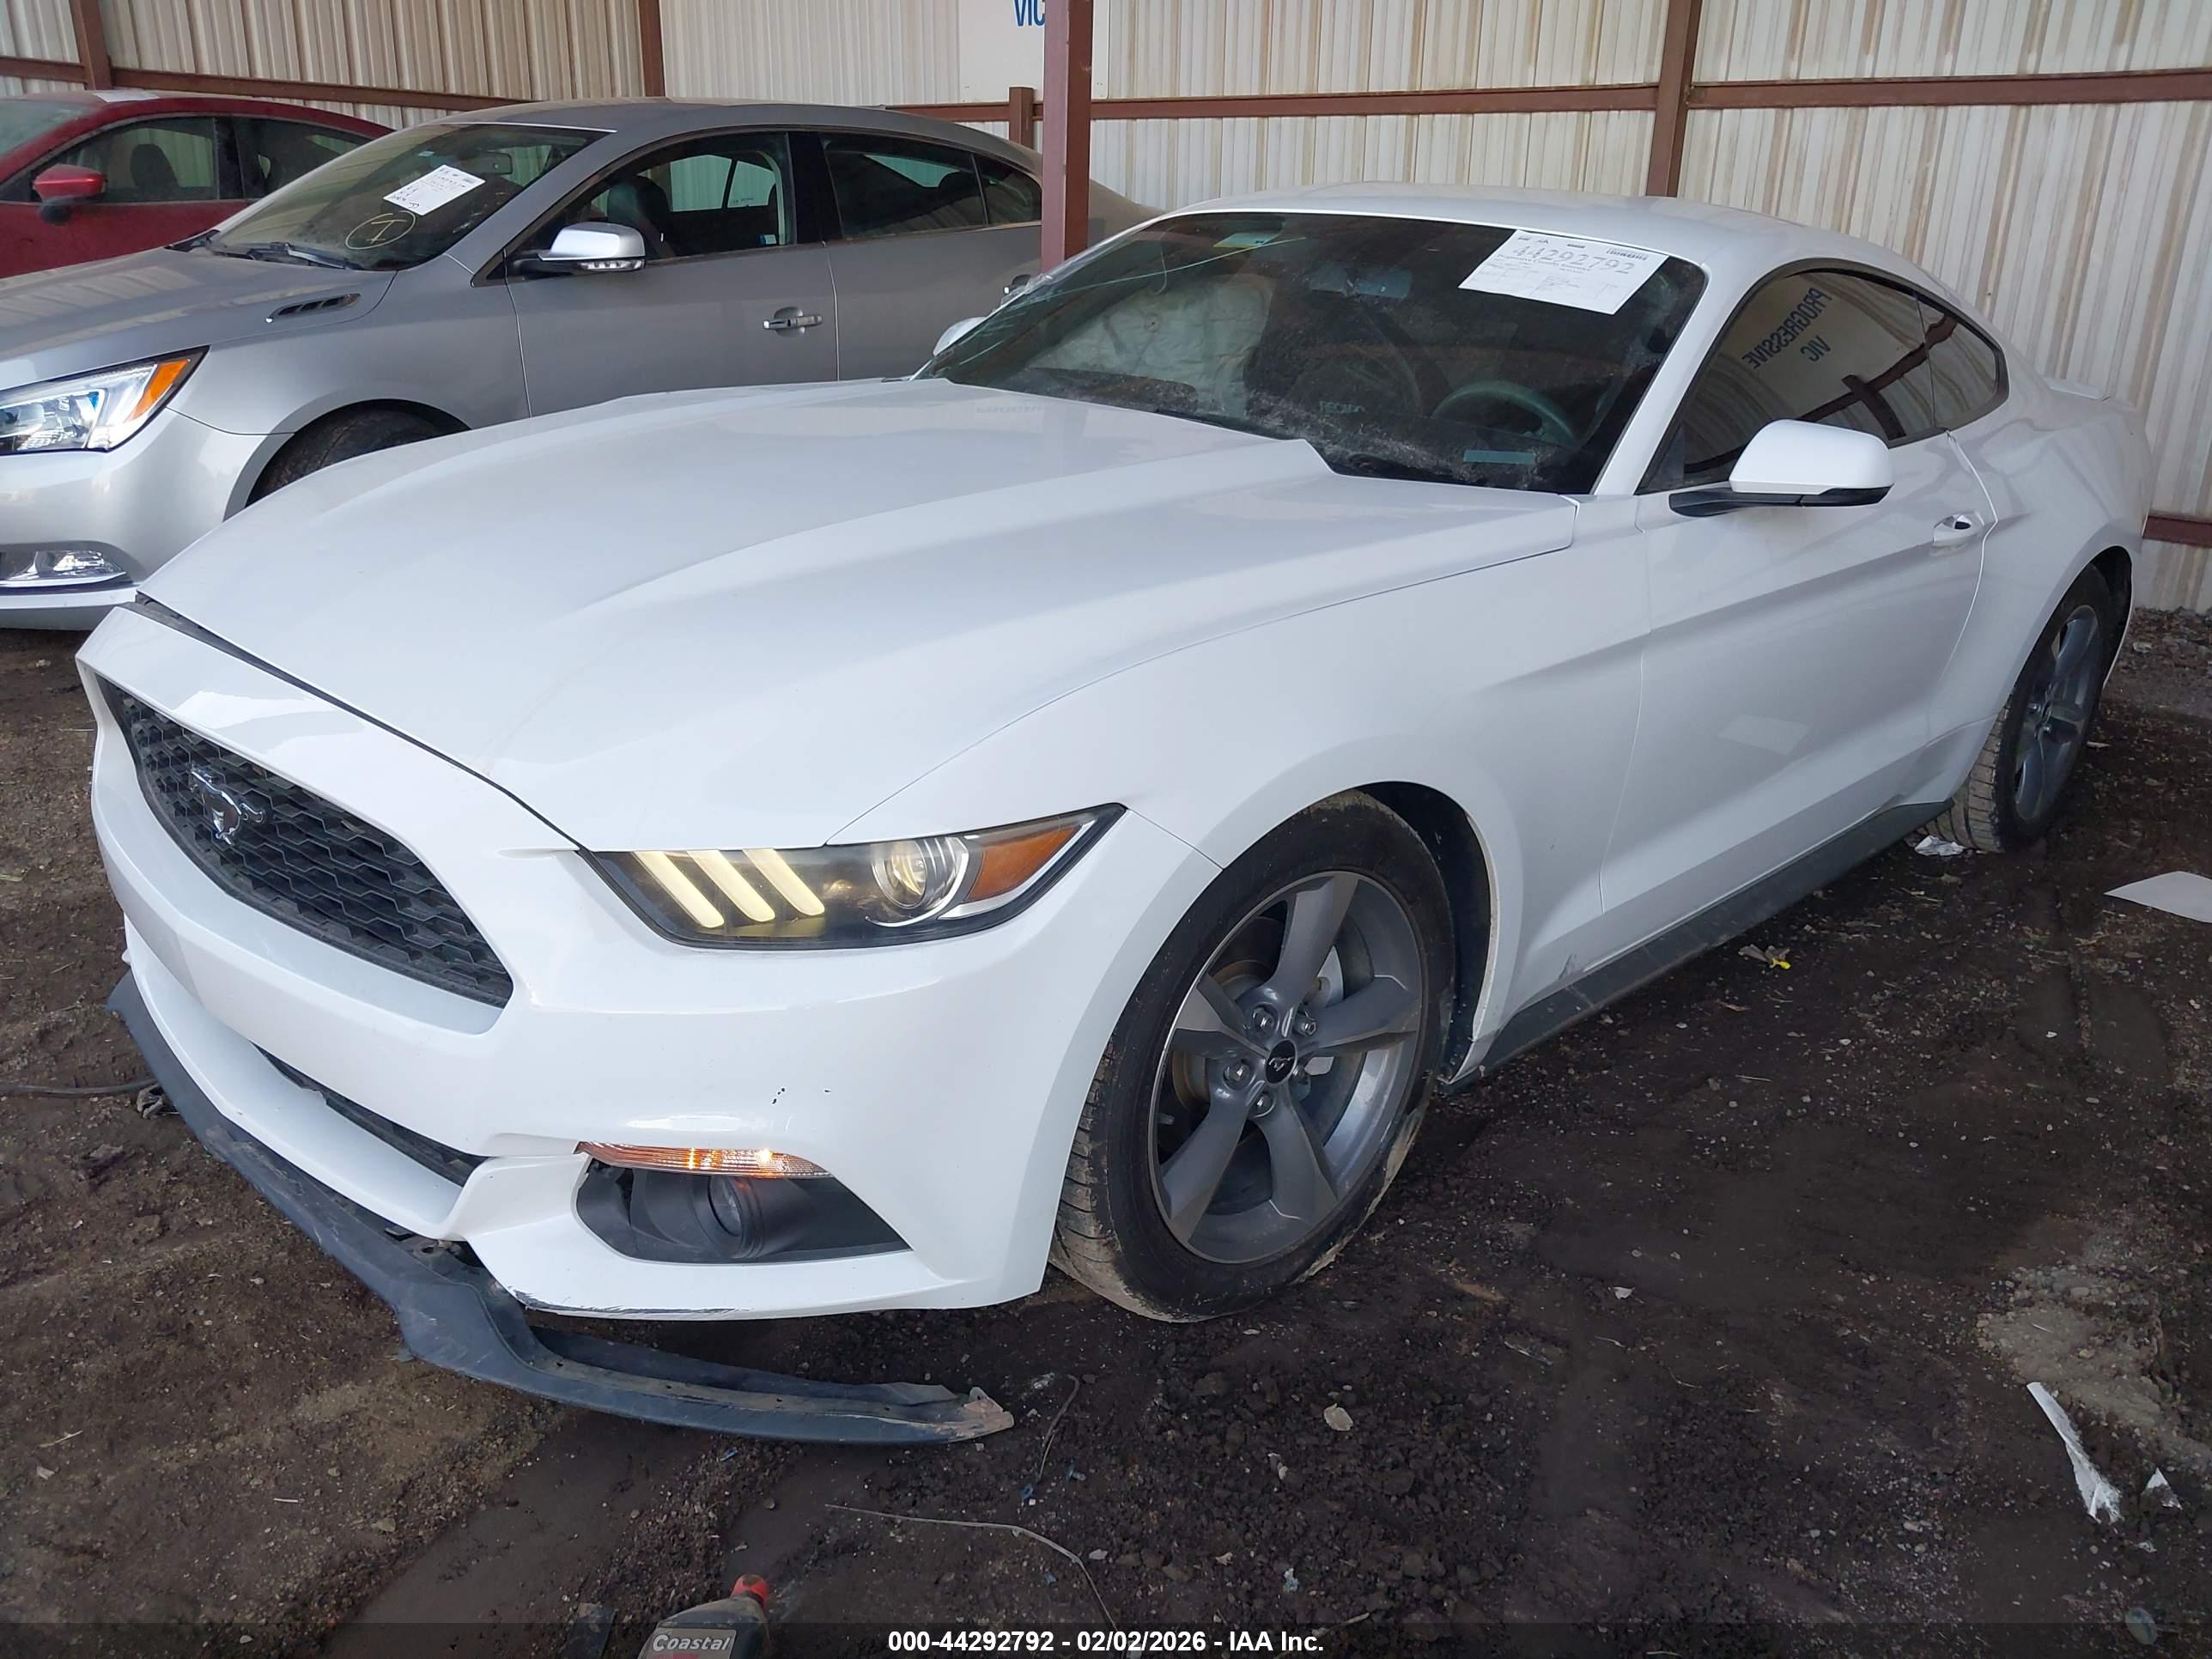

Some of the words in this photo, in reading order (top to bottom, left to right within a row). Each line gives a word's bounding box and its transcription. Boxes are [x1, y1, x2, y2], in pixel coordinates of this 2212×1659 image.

[1014, 0, 1045, 27] VIC
[1513, 246, 1636, 275] 44292792
[653, 1634, 731, 1652] Coastal
